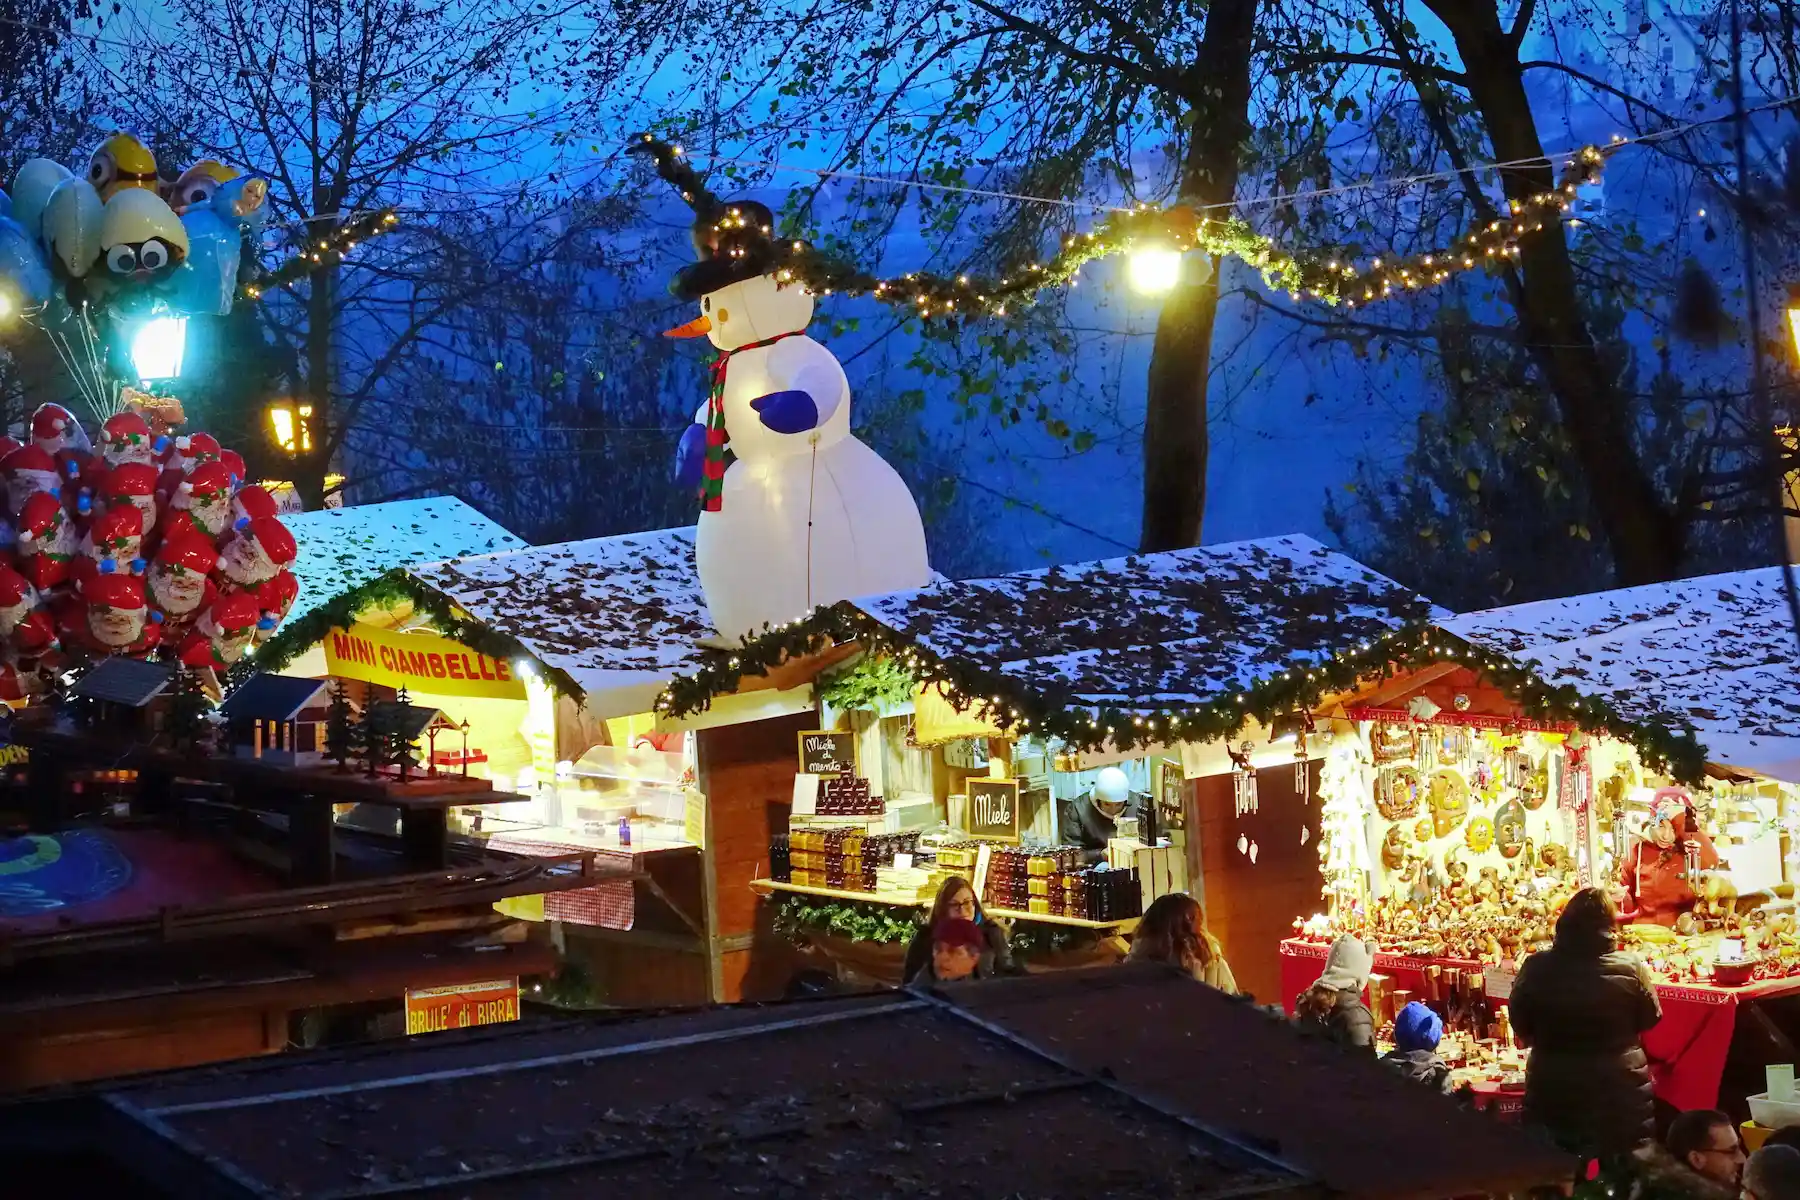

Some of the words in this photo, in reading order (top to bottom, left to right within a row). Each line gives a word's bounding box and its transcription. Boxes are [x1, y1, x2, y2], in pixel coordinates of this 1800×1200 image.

[333, 634, 377, 667] MINI
[379, 644, 511, 682] CIAMBELLE
[805, 736, 836, 752] Miele
[974, 793, 1011, 826] Miele
[458, 1003, 470, 1028] di
[477, 998, 515, 1025] BIRRA
